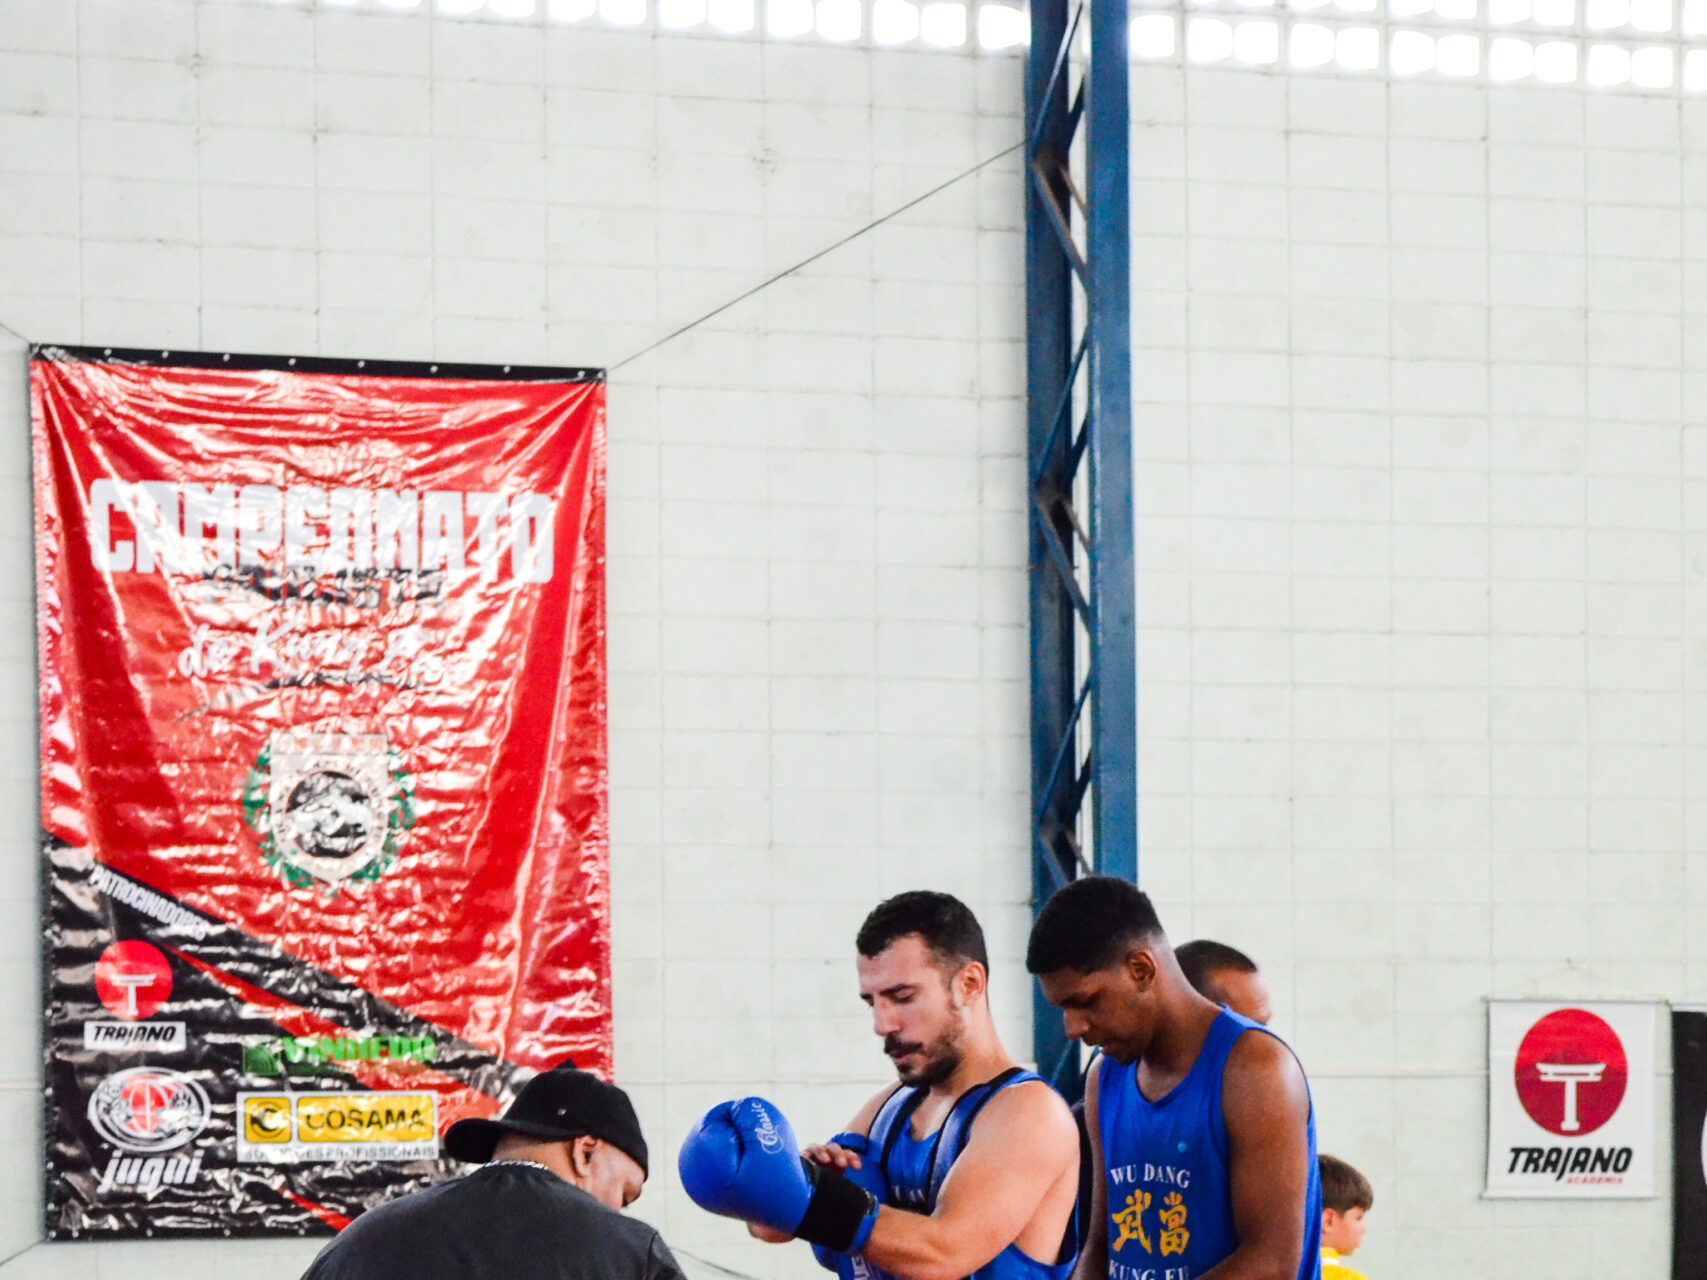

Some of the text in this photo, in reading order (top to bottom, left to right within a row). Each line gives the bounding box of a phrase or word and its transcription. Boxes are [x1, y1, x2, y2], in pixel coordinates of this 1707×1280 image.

[90, 478, 556, 584] CAMPEONATO
[93, 1025, 177, 1045] TRAJANO
[305, 1108, 426, 1131] COSAMA
[96, 1149, 205, 1198] jugui
[1110, 1163, 1191, 1189] WU DANG
[1508, 1146, 1634, 1181] TRAJANO
